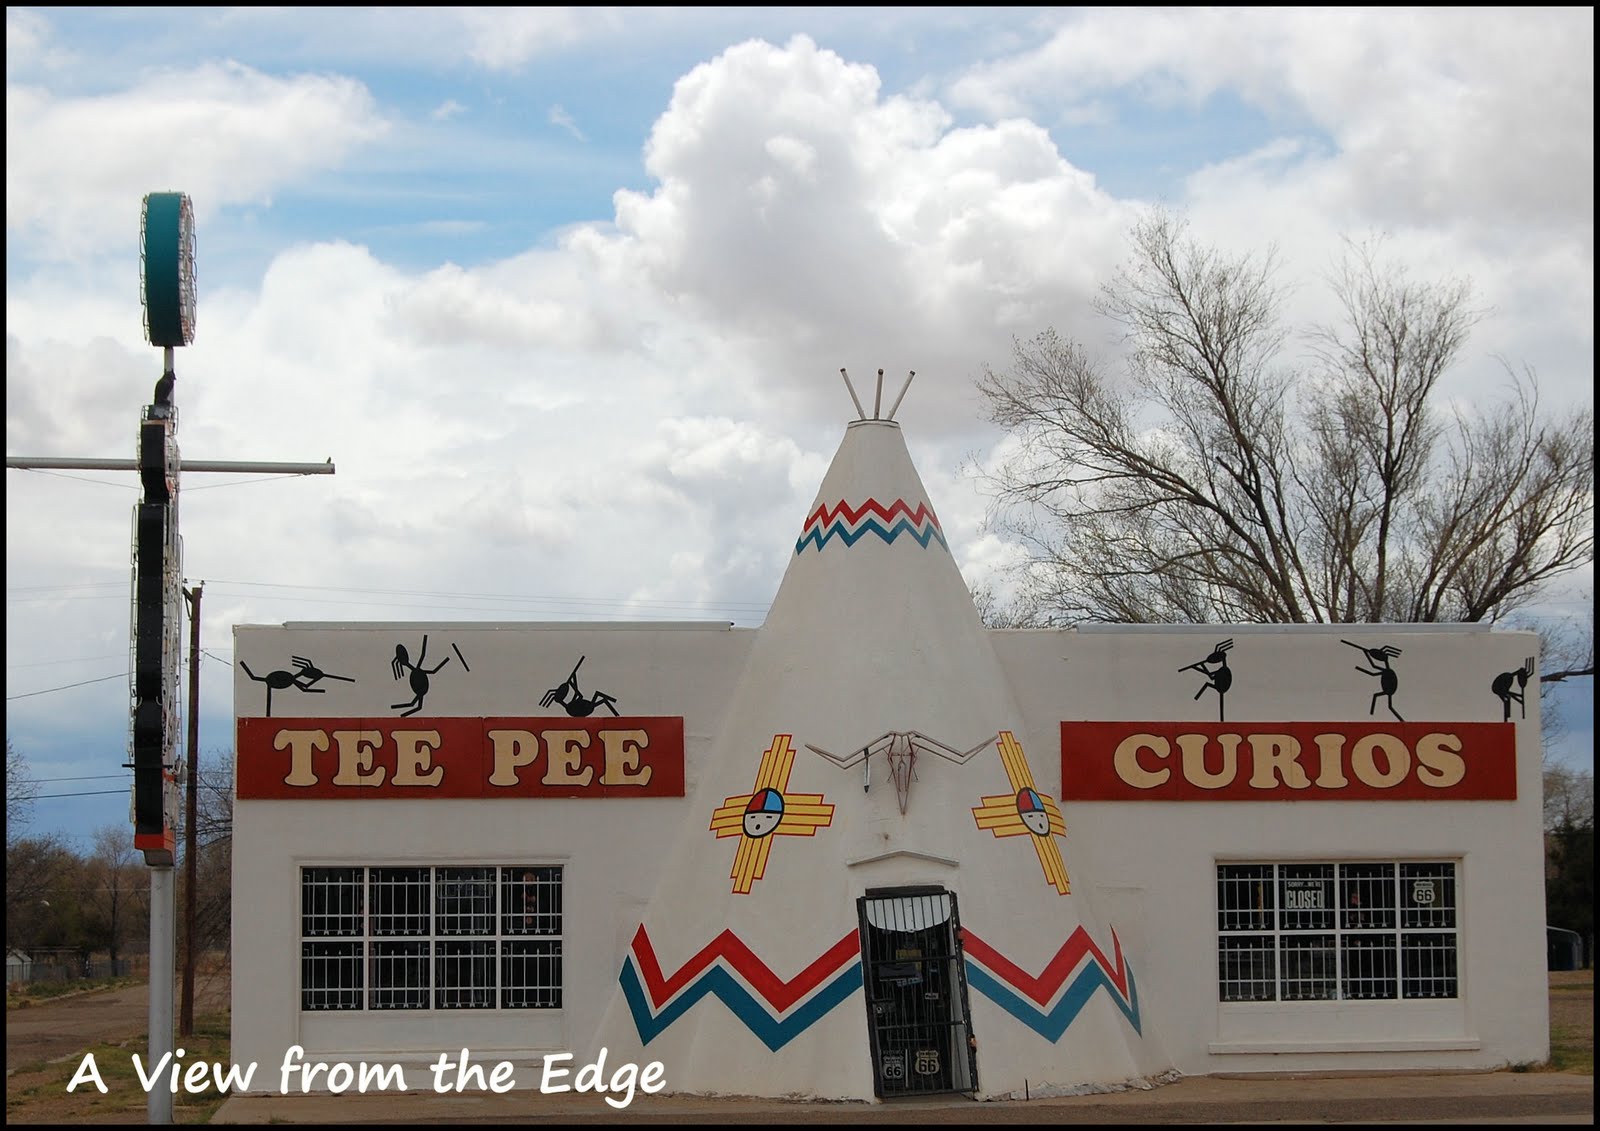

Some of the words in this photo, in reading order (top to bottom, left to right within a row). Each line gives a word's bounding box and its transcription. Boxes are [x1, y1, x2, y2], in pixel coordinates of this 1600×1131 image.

[274, 729, 443, 787] TEE
[488, 729, 651, 787] PEE
[1113, 732, 1466, 789] CURIOS
[1287, 890, 1322, 909] CLOSED
[1417, 890, 1432, 901] 66
[886, 1066, 901, 1076] 66
[919, 1059, 936, 1072] 66
